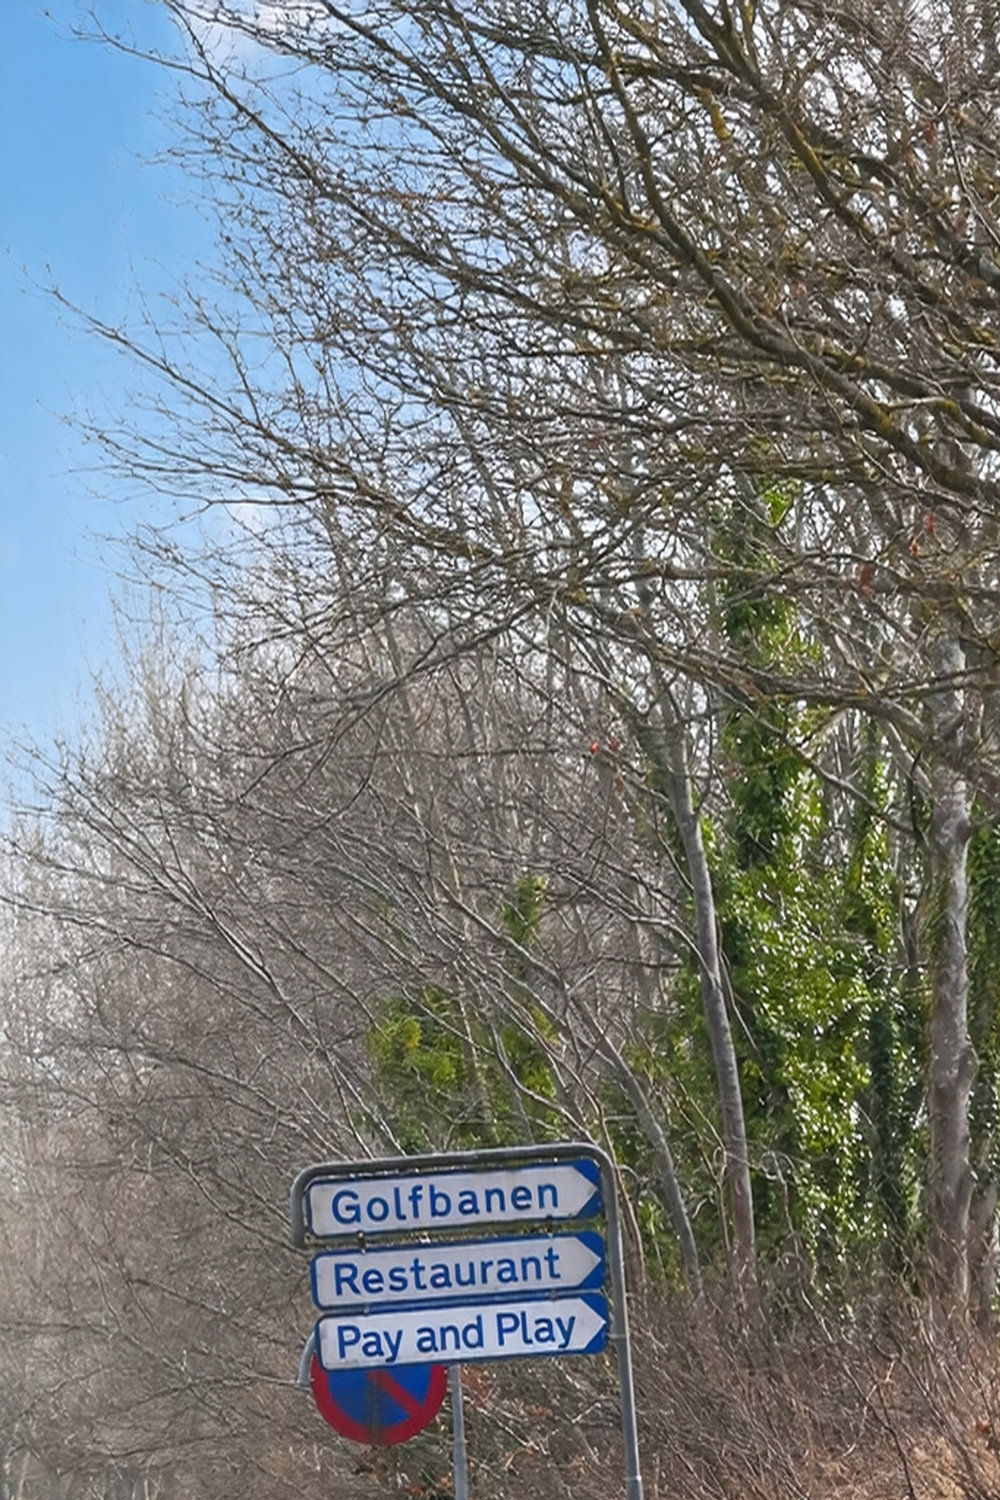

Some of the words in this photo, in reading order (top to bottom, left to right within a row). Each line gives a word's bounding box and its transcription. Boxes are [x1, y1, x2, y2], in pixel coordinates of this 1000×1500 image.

[332, 1183, 559, 1225] Golfbanen
[334, 1247, 561, 1296] Restaurant
[337, 1325, 402, 1363] Pay
[416, 1315, 485, 1353] and
[496, 1312, 576, 1349] Play
